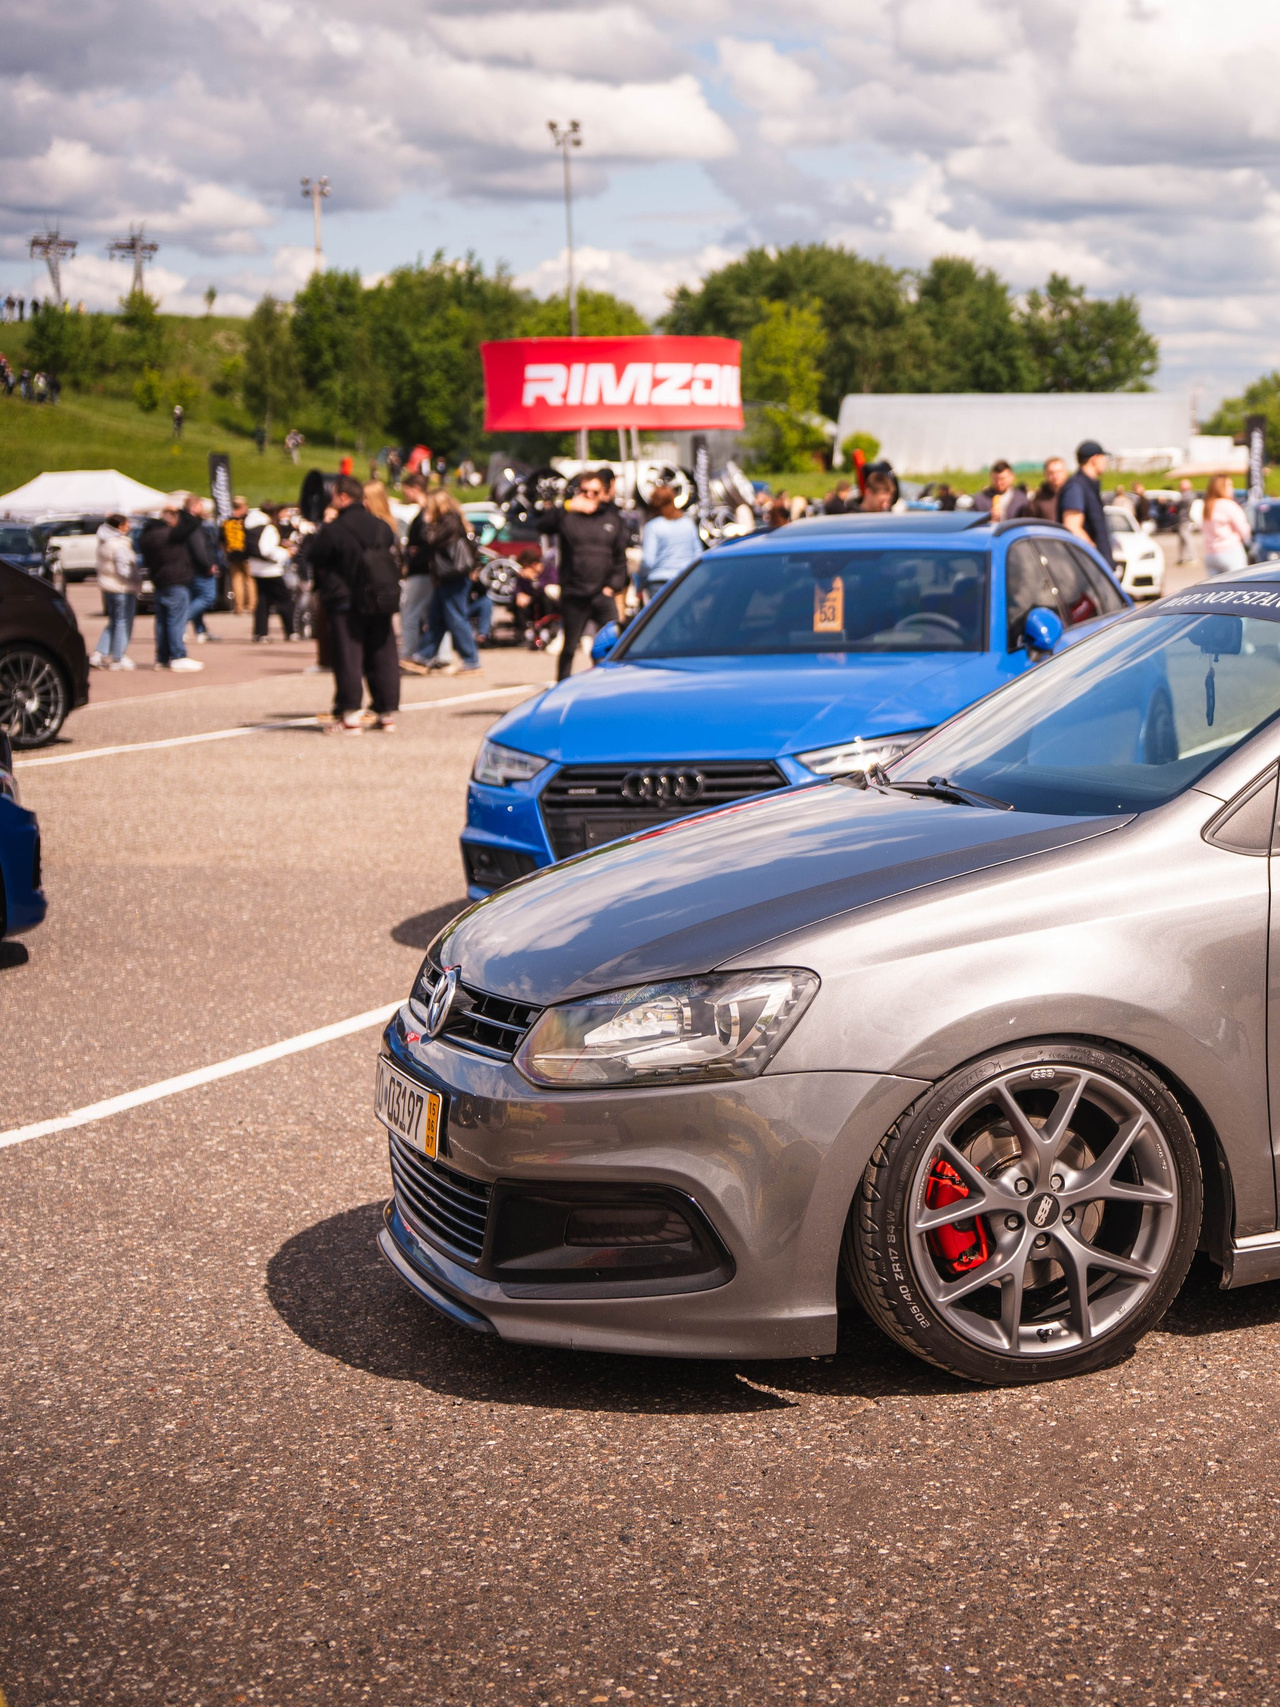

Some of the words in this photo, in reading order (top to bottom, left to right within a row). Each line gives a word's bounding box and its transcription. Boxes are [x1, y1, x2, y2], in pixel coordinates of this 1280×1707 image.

[1193, 591, 1248, 604] NOT
[820, 605, 836, 622] 53
[387, 1075, 424, 1141] 03197
[429, 1102, 436, 1116] 15
[427, 1118, 434, 1133] 06
[426, 1134, 434, 1149] 07
[888, 1247, 904, 1282] ZR17
[898, 1285, 930, 1329] 205/40
